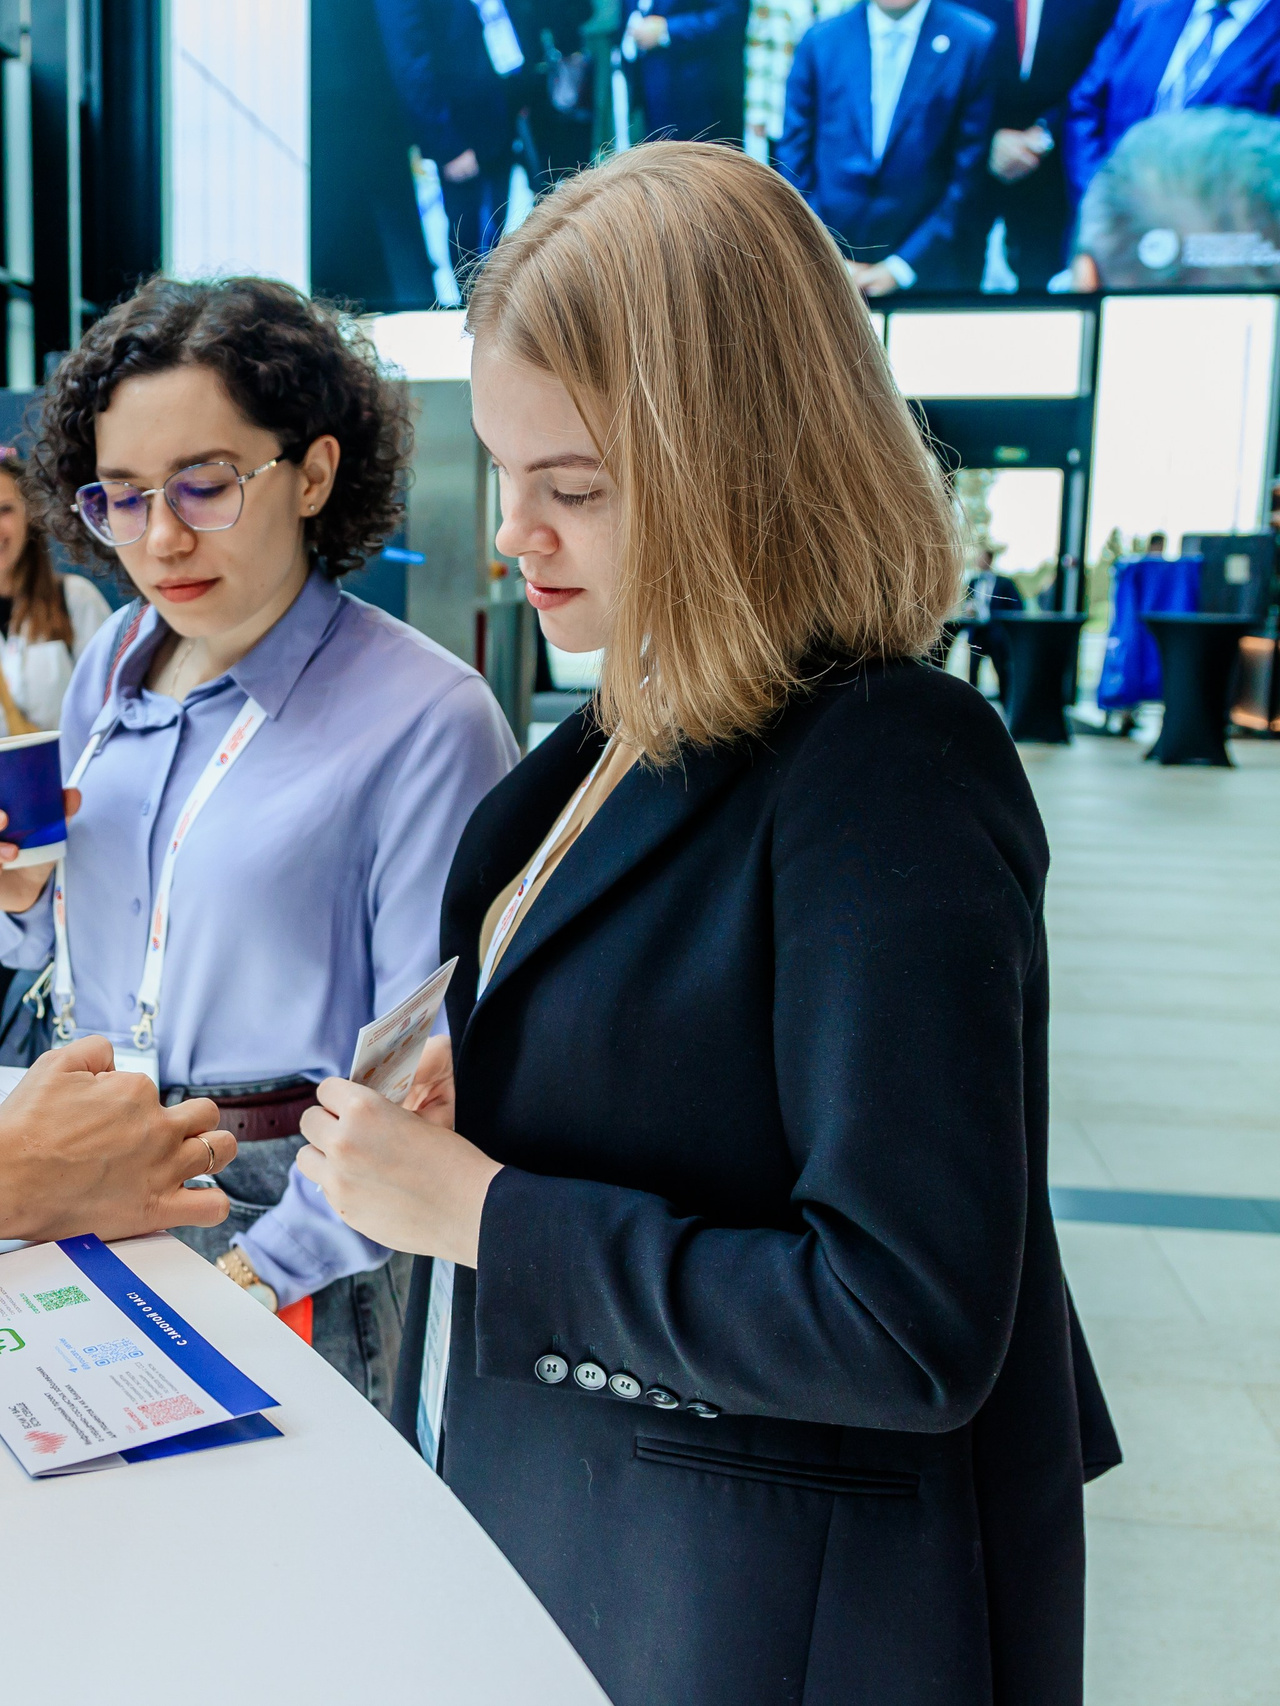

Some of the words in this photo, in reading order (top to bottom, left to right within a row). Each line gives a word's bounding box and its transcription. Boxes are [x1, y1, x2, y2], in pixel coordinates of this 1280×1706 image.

[126, 1292, 146, 1306] ВАС!
[146, 1312, 181, 1339] ЗАБОТОЙ
[8, 1406, 20, 1414] ВАС
